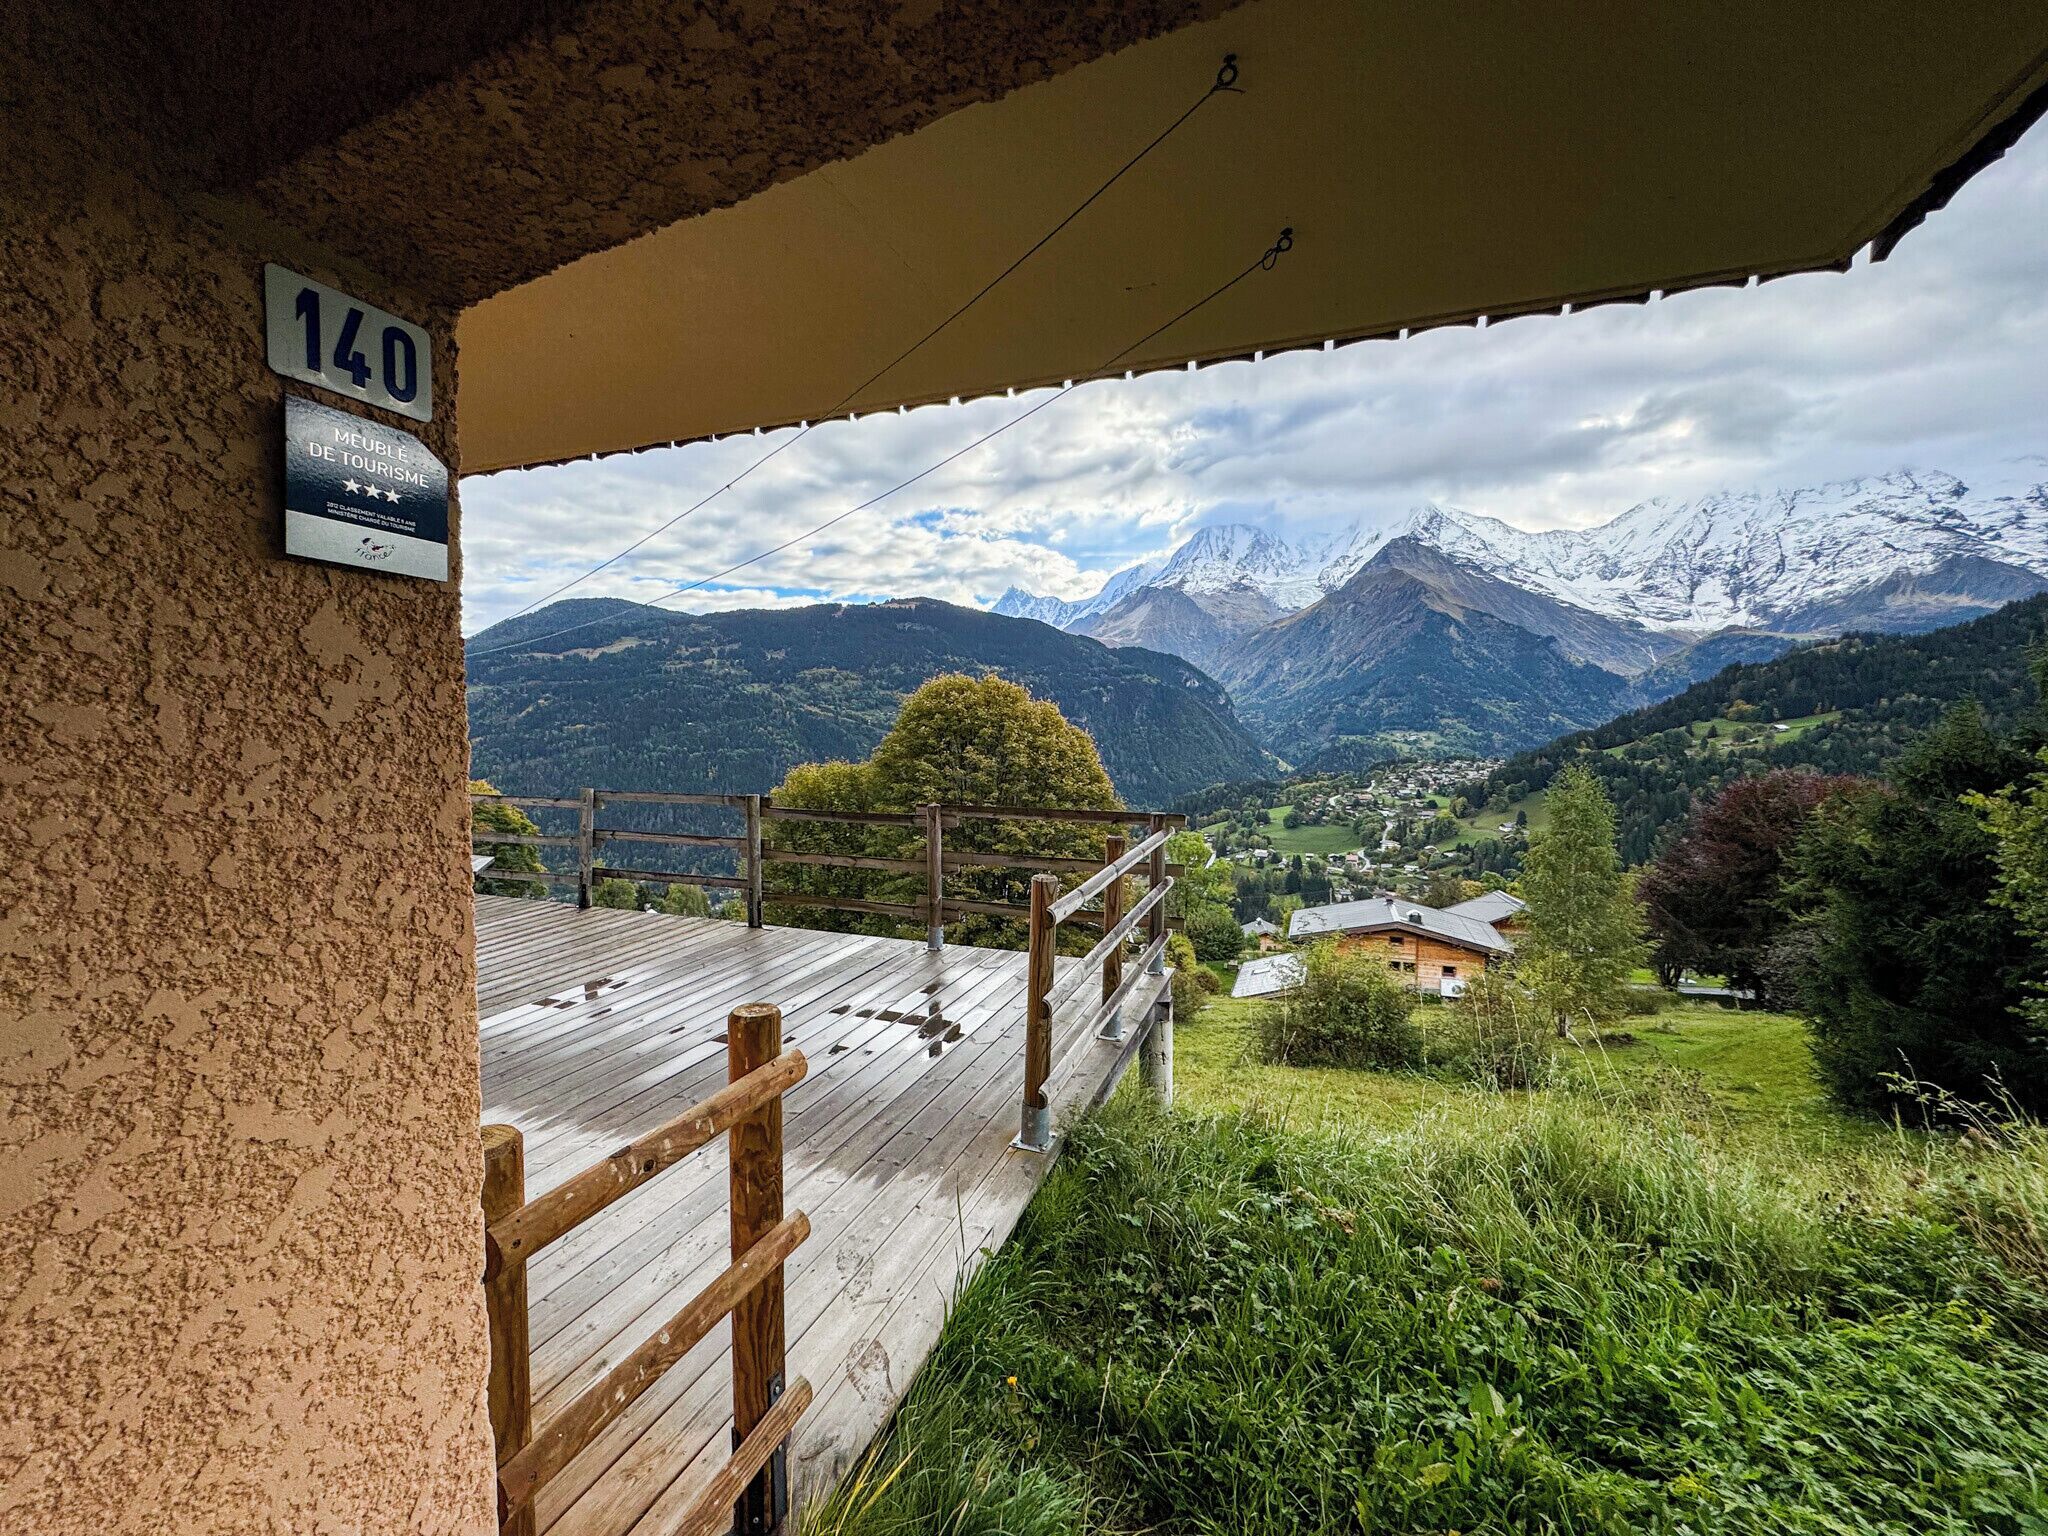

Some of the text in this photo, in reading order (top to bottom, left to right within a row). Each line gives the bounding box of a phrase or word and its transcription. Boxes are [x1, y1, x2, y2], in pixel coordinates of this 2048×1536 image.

[296, 288, 417, 403] 140
[335, 428, 408, 463] MEUBLÉ
[309, 442, 430, 488] DE TOURISME
[339, 504, 376, 518] CLASSEMENT
[376, 513, 400, 523] VALABLE
[390, 522, 416, 532] TOURISME
